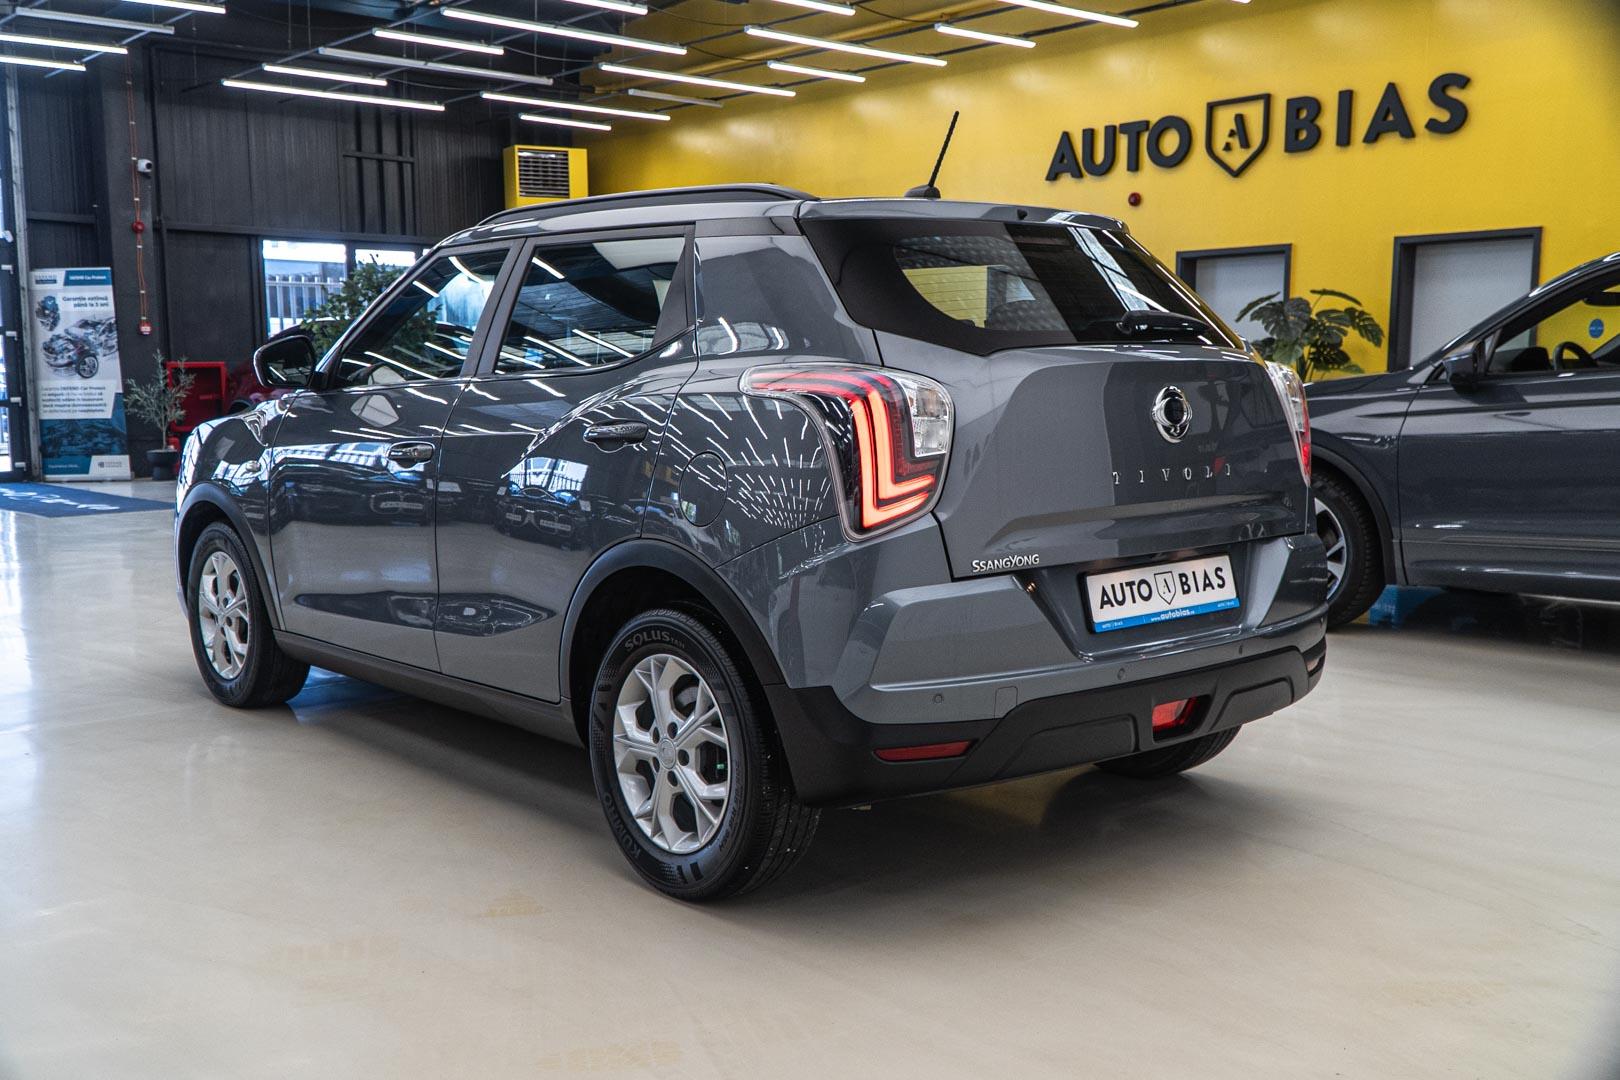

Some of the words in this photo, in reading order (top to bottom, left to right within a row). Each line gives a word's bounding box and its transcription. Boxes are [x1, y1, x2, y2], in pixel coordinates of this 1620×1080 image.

[1045, 115, 1193, 181] AUTO
[1284, 72, 1471, 153] BIAS
[1112, 463, 1231, 485] TIVOLI
[1099, 578, 1153, 609] AUTO
[1178, 566, 1226, 595] BIAS
[624, 630, 670, 652] SOLUS
